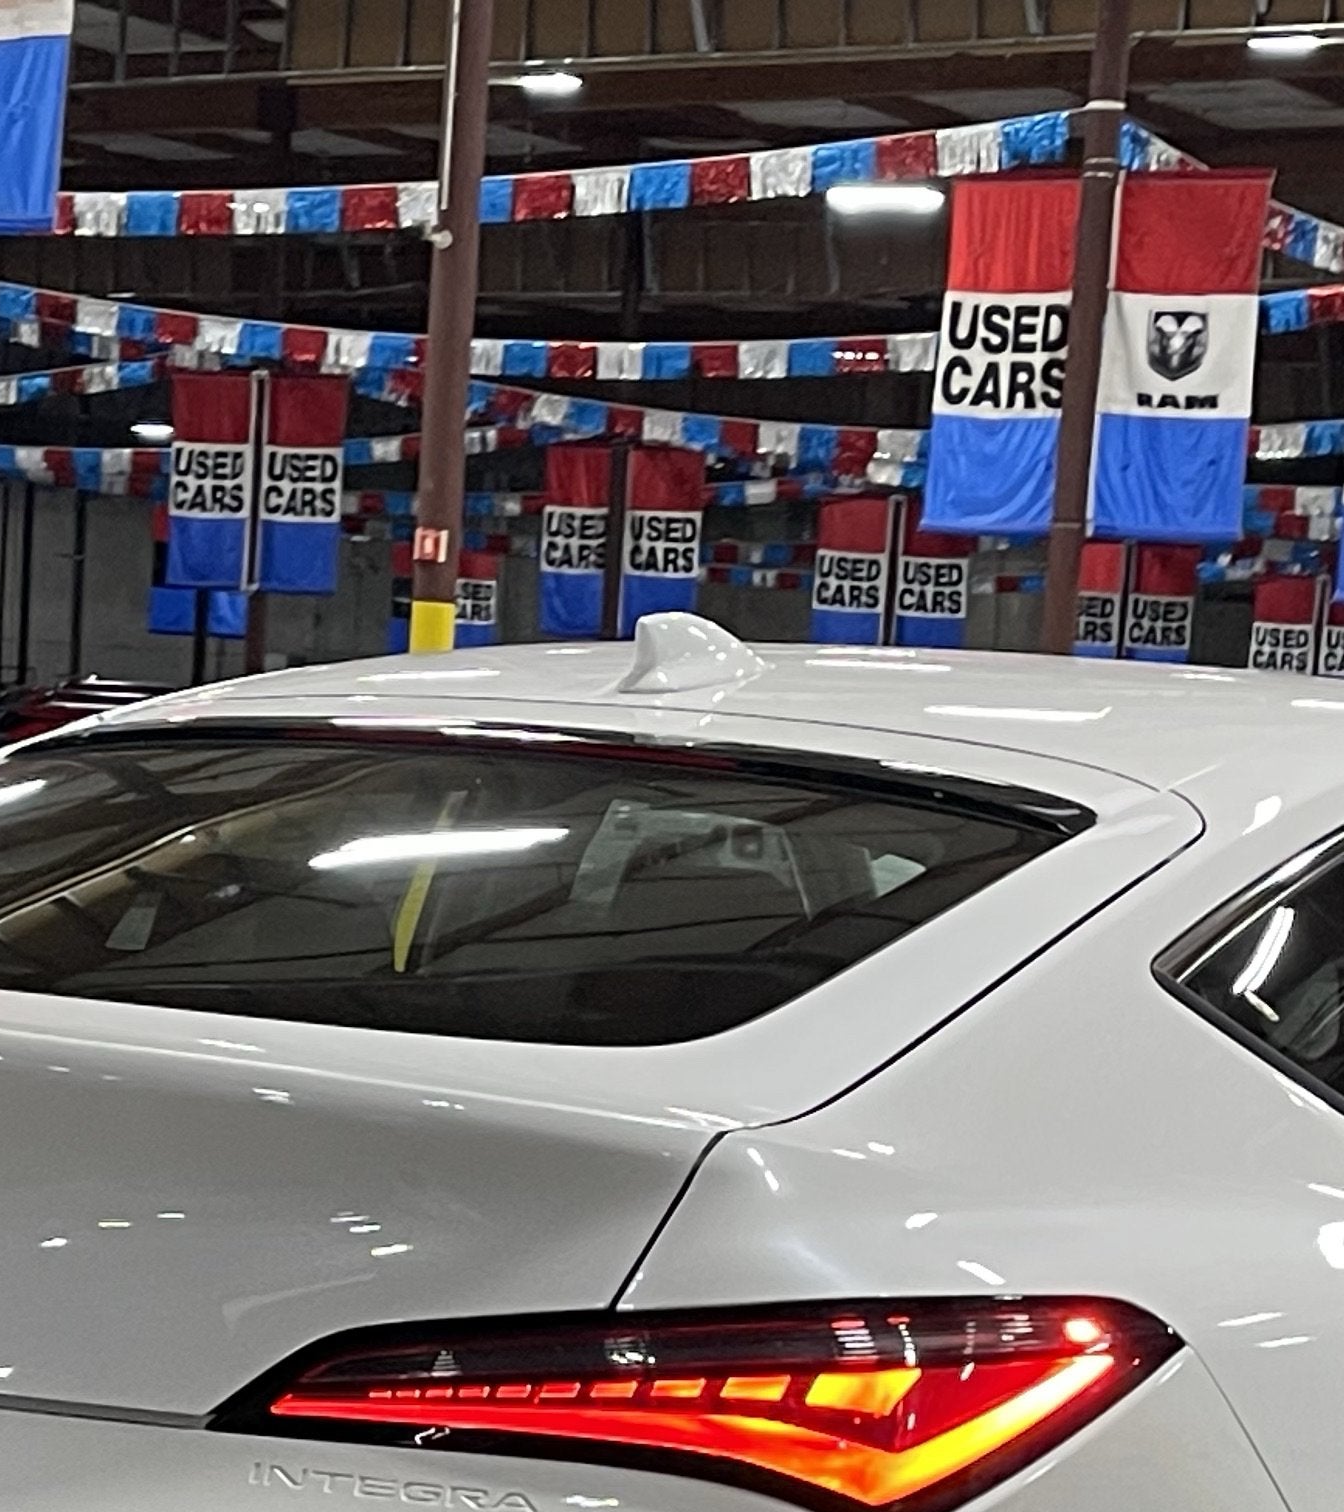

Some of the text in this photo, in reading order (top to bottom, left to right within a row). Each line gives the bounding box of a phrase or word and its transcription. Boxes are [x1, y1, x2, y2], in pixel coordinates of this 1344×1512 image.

[948, 301, 1070, 354] USED
[941, 355, 1067, 409] CARS
[1136, 393, 1219, 409] RAM
[175, 448, 244, 480] USED
[268, 451, 338, 483] USED
[174, 481, 244, 513] CARS
[264, 485, 336, 517] CARS
[632, 514, 697, 543] USED
[630, 544, 695, 573] CARS
[818, 554, 882, 582] USED
[902, 560, 963, 588] USED
[460, 582, 493, 600] SED
[816, 581, 880, 609] CARS
[899, 588, 963, 614] CARS
[455, 603, 492, 621] ARS
[1132, 597, 1189, 622] USED
[1129, 622, 1187, 646] CARS
[1256, 626, 1309, 649] USED
[1253, 649, 1309, 671] CARS
